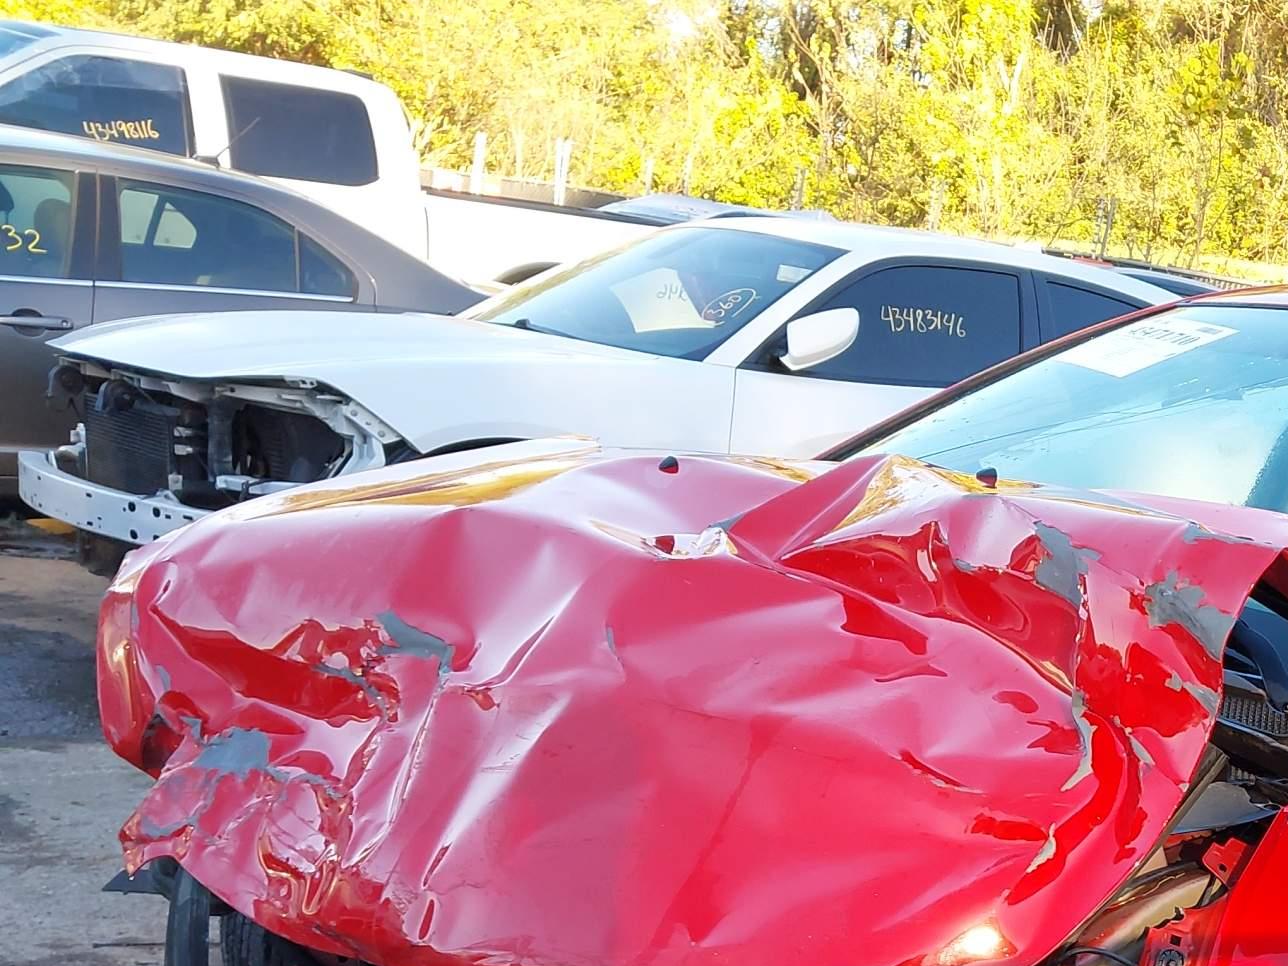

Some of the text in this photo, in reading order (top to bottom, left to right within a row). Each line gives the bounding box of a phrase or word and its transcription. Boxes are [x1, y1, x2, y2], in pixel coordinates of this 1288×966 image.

[82, 119, 160, 141] 43498116
[1, 224, 48, 253] 32
[881, 305, 967, 338] 43483146
